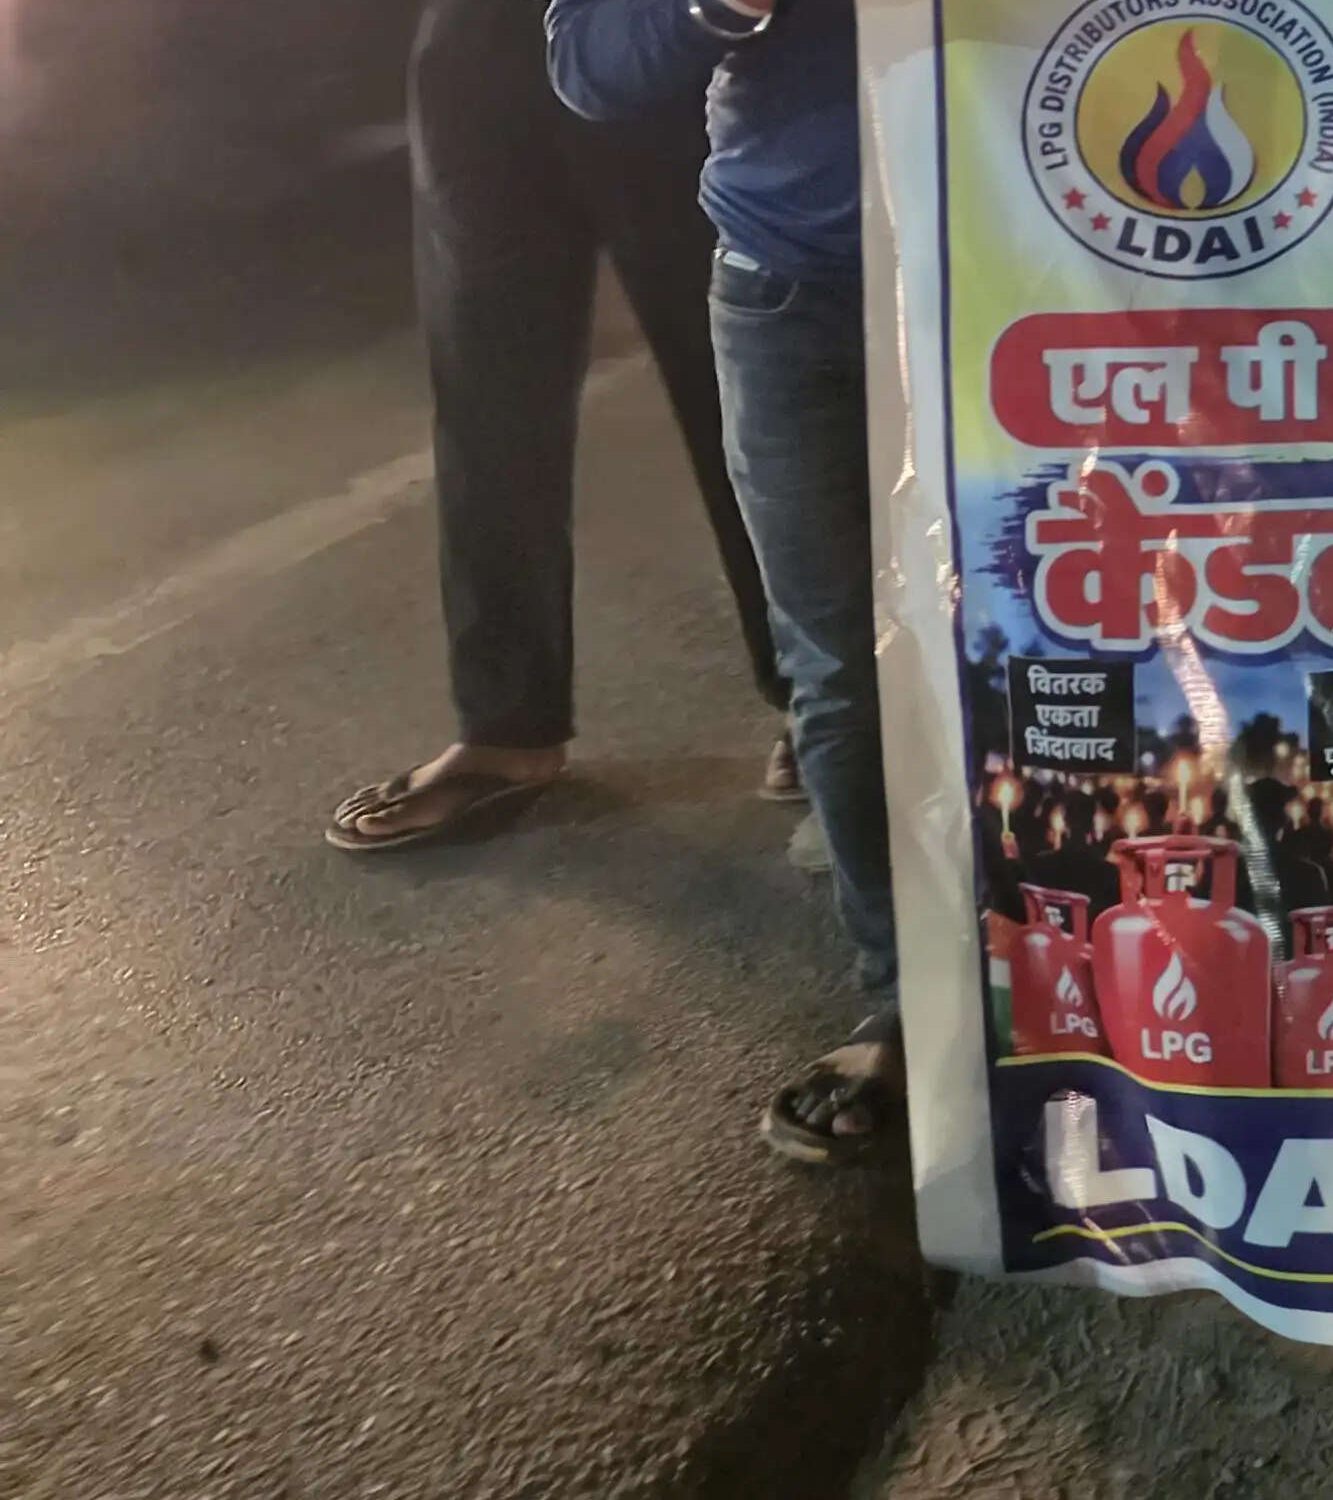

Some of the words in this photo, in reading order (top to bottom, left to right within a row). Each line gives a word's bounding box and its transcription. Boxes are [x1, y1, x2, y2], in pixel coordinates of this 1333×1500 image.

[1039, 122, 1069, 170] LPG
[1116, 216, 1265, 264] LDAI
[1042, 346, 1199, 425] एल
[1220, 321, 1327, 422] पी
[1027, 664, 1107, 695] वितरक
[1035, 705, 1100, 728] एकता
[1024, 727, 1117, 761] जिंदाबाद
[1050, 1012, 1098, 1038] LPG
[1140, 1028, 1212, 1063] LPG
